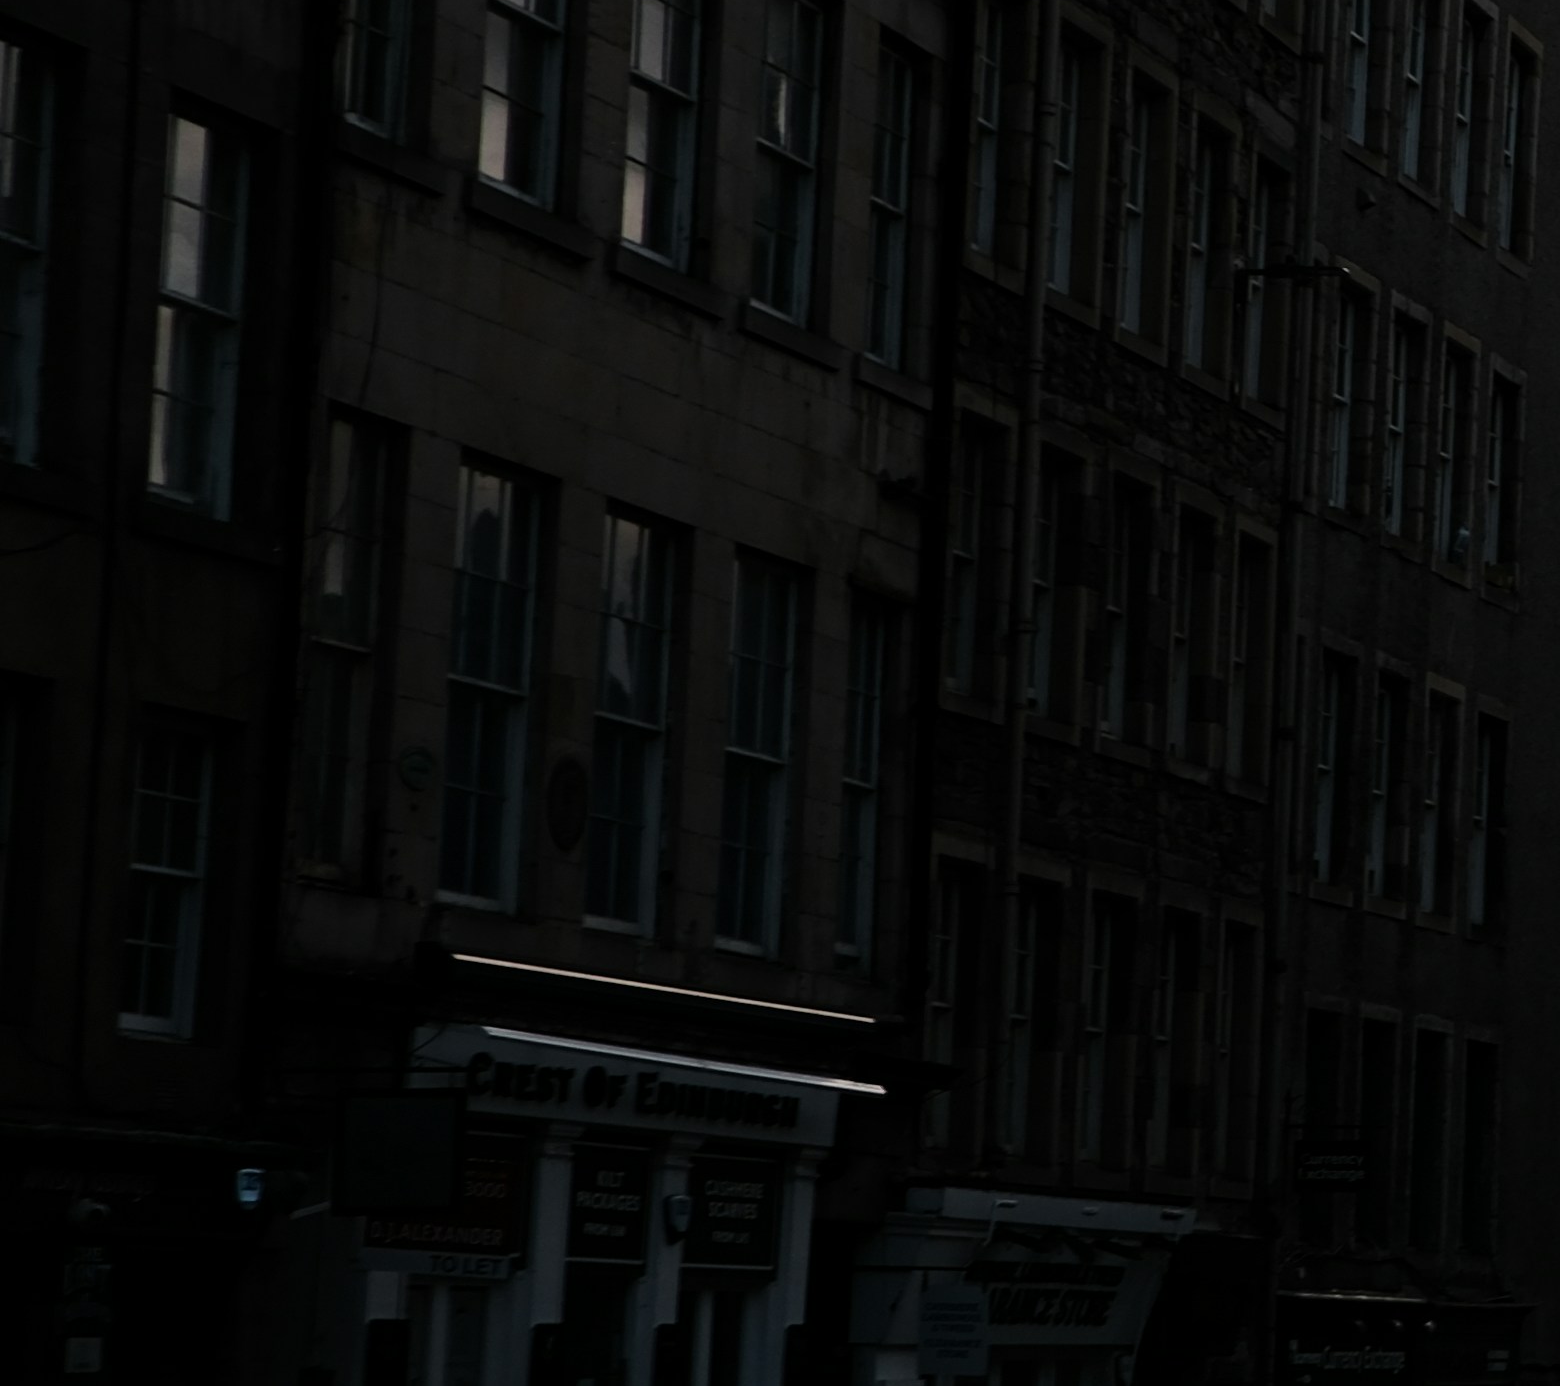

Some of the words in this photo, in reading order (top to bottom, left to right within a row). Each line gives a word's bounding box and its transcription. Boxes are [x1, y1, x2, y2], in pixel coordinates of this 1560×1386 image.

[466, 1051, 576, 1104] CREST
[636, 1071, 801, 1129] EDINBURGH
[429, 1255, 458, 1274] TO
[463, 1256, 503, 1276] LET
